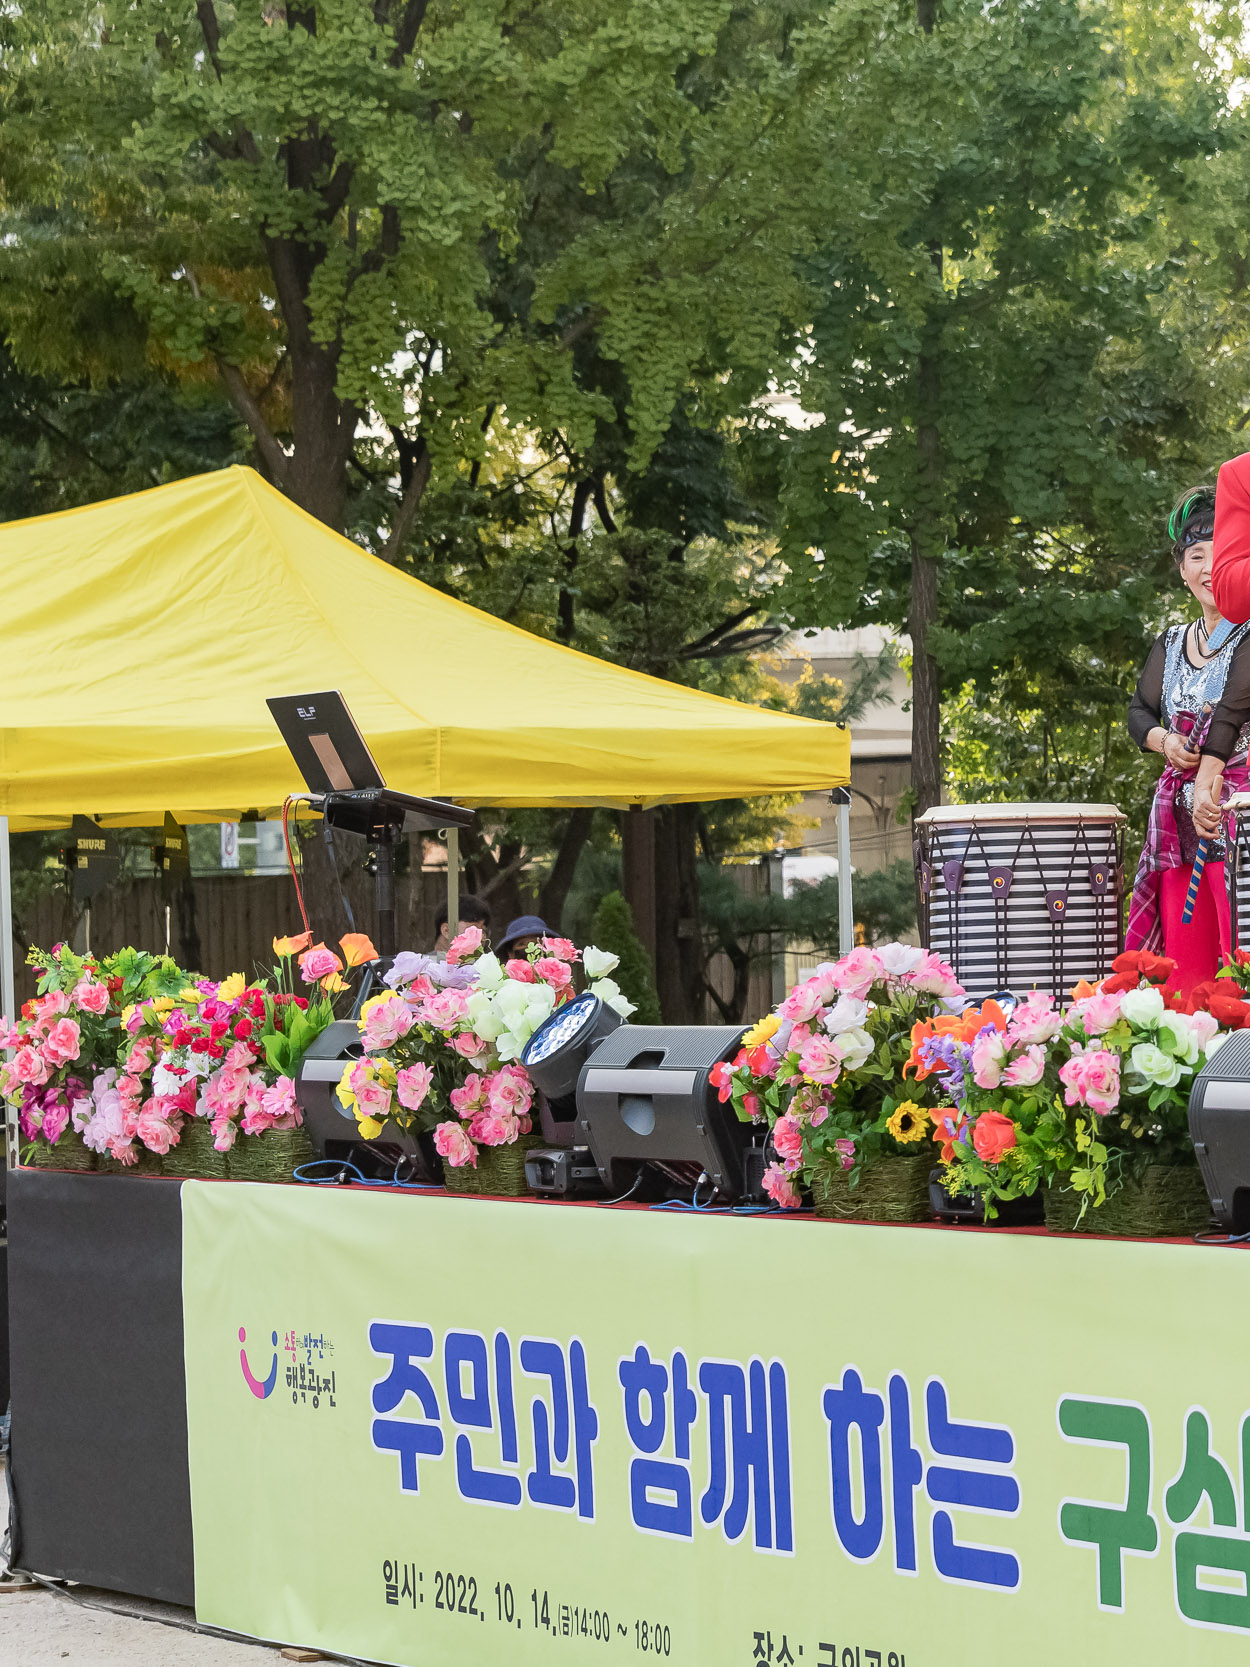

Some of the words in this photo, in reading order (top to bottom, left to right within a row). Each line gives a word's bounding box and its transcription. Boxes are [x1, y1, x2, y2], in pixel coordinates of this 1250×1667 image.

[77, 838, 106, 850] SHURE
[165, 837, 182, 850] SHURE
[285, 1362, 337, 1409] 행복광진
[368, 1319, 599, 1523] 주민과
[617, 1341, 795, 1555] 함께
[820, 1364, 1022, 1592] 하는
[382, 1559, 424, 1610] 일시:
[434, 1570, 485, 1622] 2022.
[494, 1581, 522, 1629] 10.
[635, 1619, 671, 1657] 18:00
